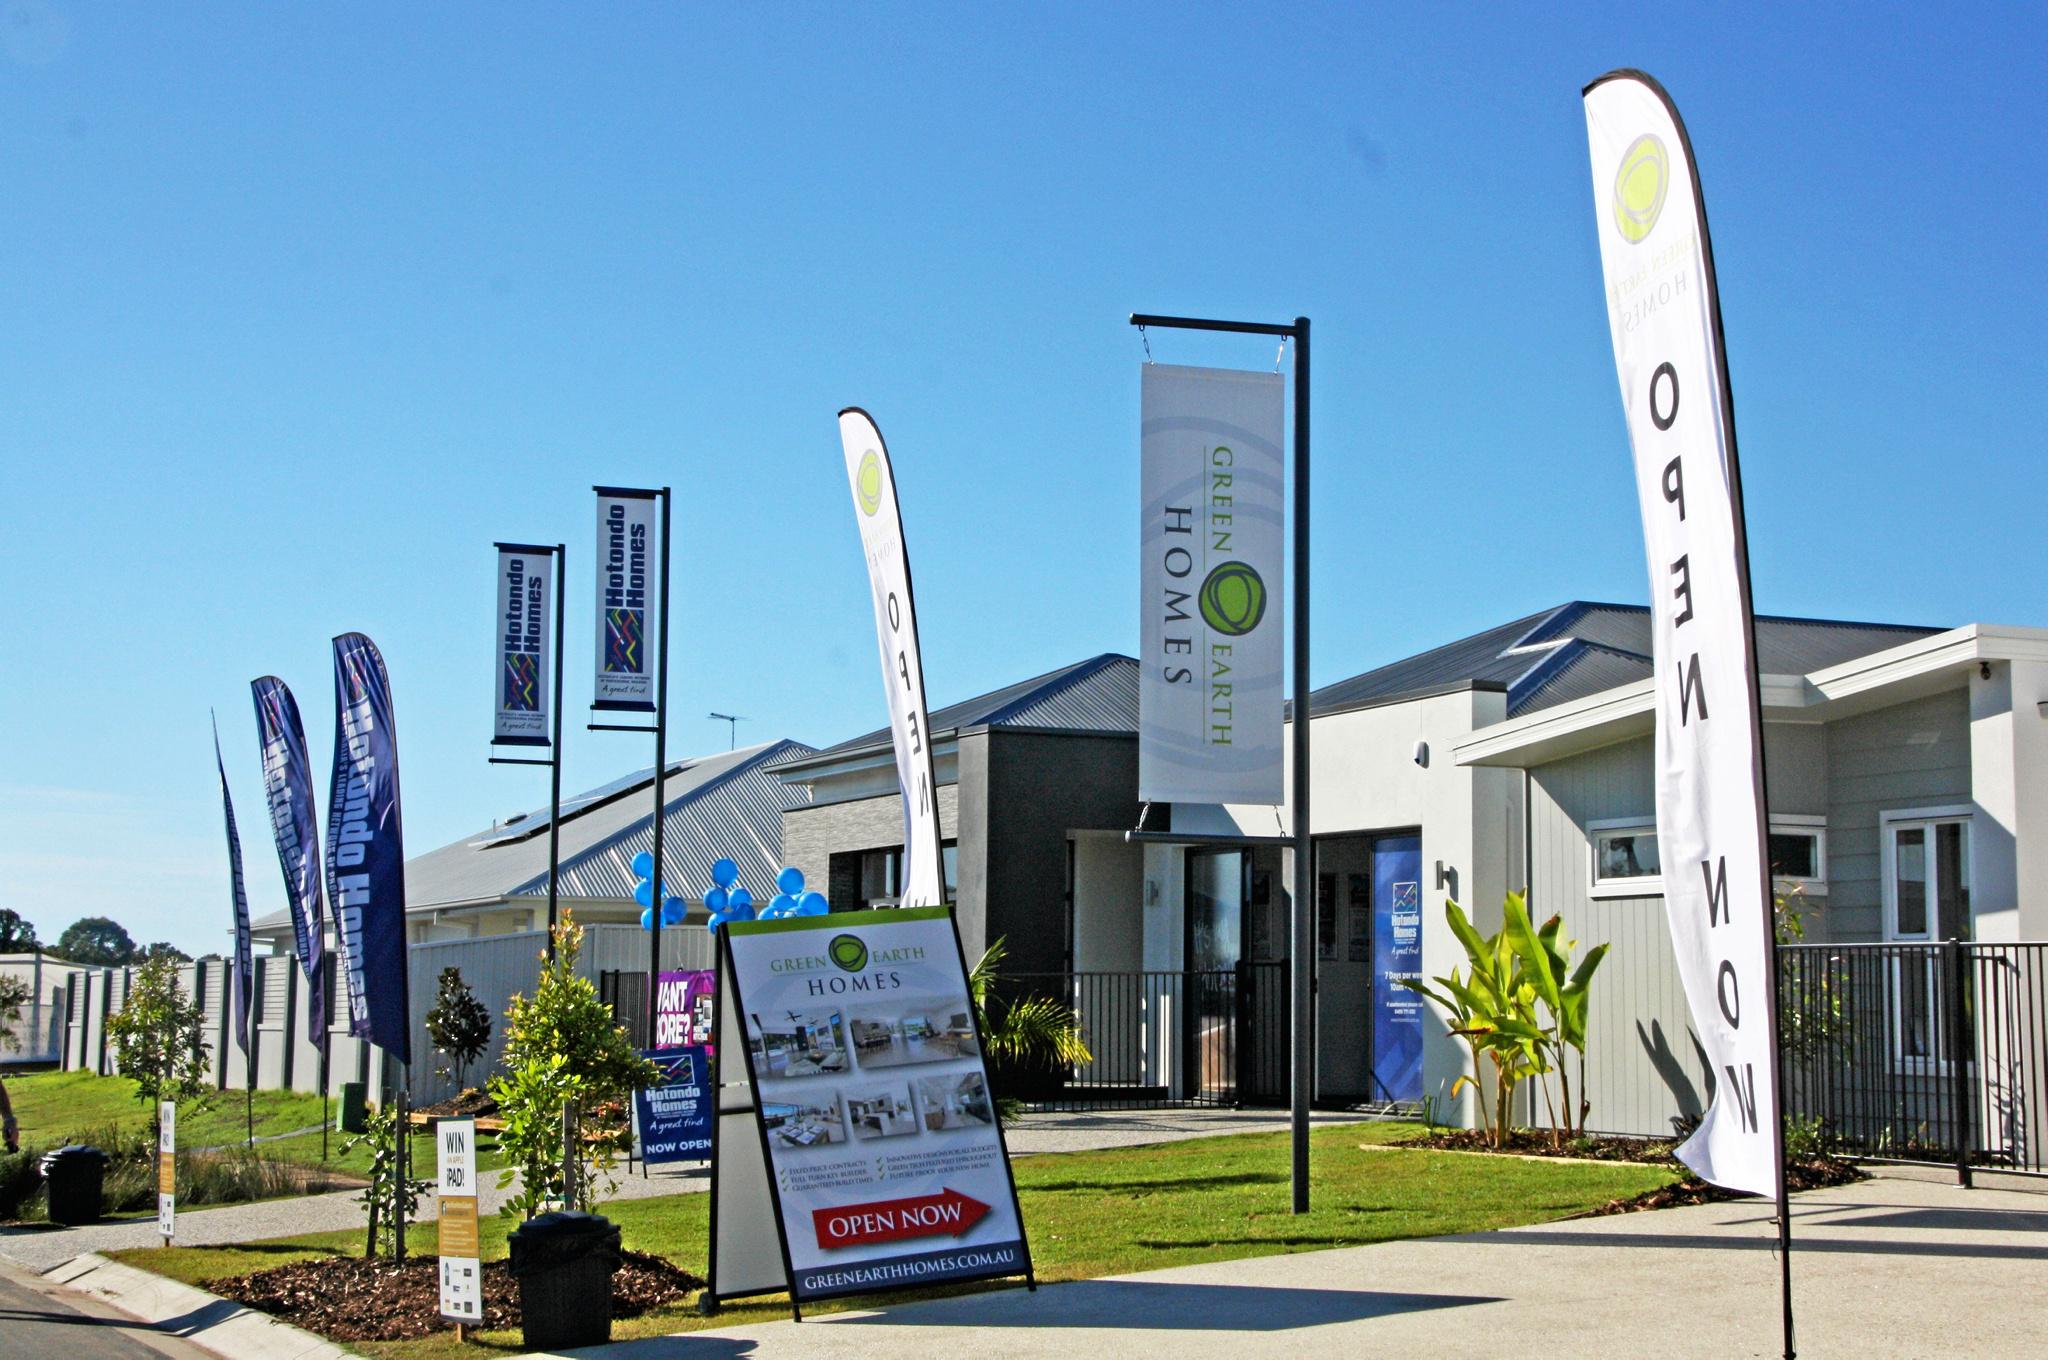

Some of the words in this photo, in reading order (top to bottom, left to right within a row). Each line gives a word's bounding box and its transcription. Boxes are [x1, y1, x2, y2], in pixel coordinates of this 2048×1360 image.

[1212, 445, 1233, 553] GREEN
[605, 504, 625, 607] Hotondo
[626, 523, 646, 608] Homes
[505, 558, 524, 652] Hotondo
[1164, 505, 1193, 685] HOMES
[523, 575, 542, 653] Homes
[1212, 643, 1233, 746] EARTH
[336, 700, 374, 868] Hotondo
[266, 737, 307, 893] Hotondo
[1391, 914, 1419, 927] Hotondo
[1393, 926, 1417, 938] Homes
[337, 873, 370, 1021] Homes
[770, 955, 827, 972] GREEN
[872, 947, 925, 963] EARTH
[807, 971, 901, 996] HOMES
[1384, 971, 1389, 980] 7
[1389, 972, 1401, 980] Days
[657, 981, 689, 1013] ANT
[656, 1013, 691, 1044] ORE?
[645, 1086, 700, 1102] Hotondo
[651, 1099, 697, 1113] Homes
[446, 1131, 464, 1153] WIN
[649, 1121, 657, 1131] A
[658, 1118, 682, 1135] great
[684, 1117, 704, 1127] find
[646, 1142, 676, 1154] NOW
[680, 1139, 712, 1151] OPEN
[447, 1167, 464, 1187] iPAD!
[828, 1210, 895, 1238] OPEN
[901, 1202, 962, 1228] NOW
[804, 1249, 1015, 1290] GREENEARTHHOMES.COM.AU
